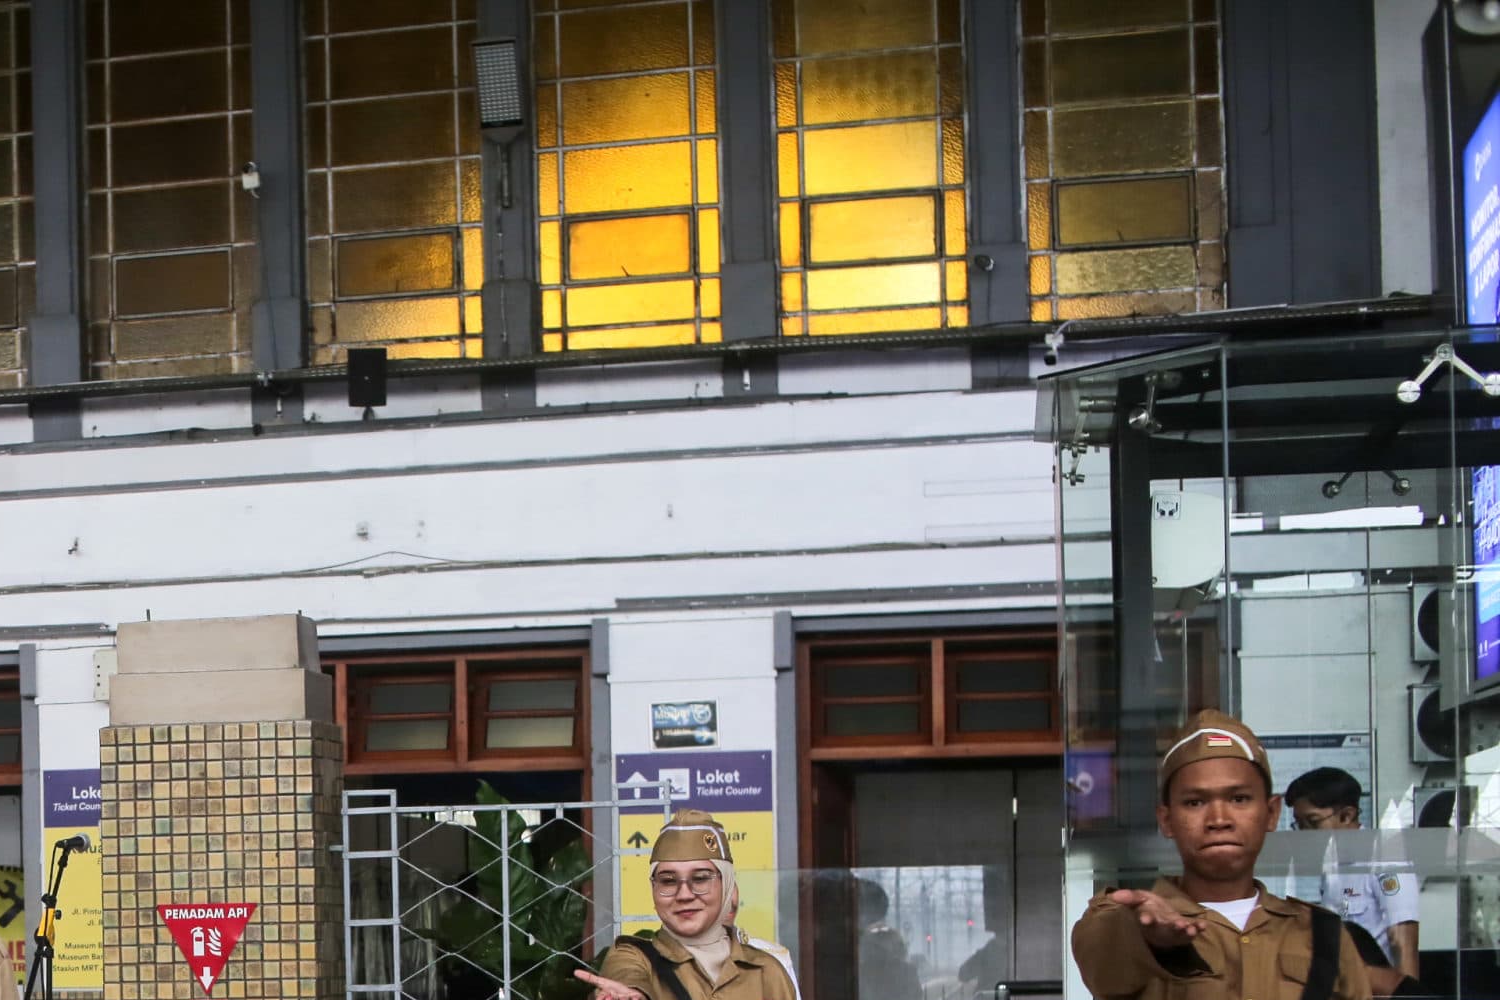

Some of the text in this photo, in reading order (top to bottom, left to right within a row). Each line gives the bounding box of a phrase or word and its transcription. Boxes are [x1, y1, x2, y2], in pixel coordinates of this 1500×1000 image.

[696, 769, 740, 784] Loket
[696, 785, 762, 796] Ticket Counter
[53, 802, 101, 812] Ticket Coun
[165, 907, 248, 919] PEMADAM API
